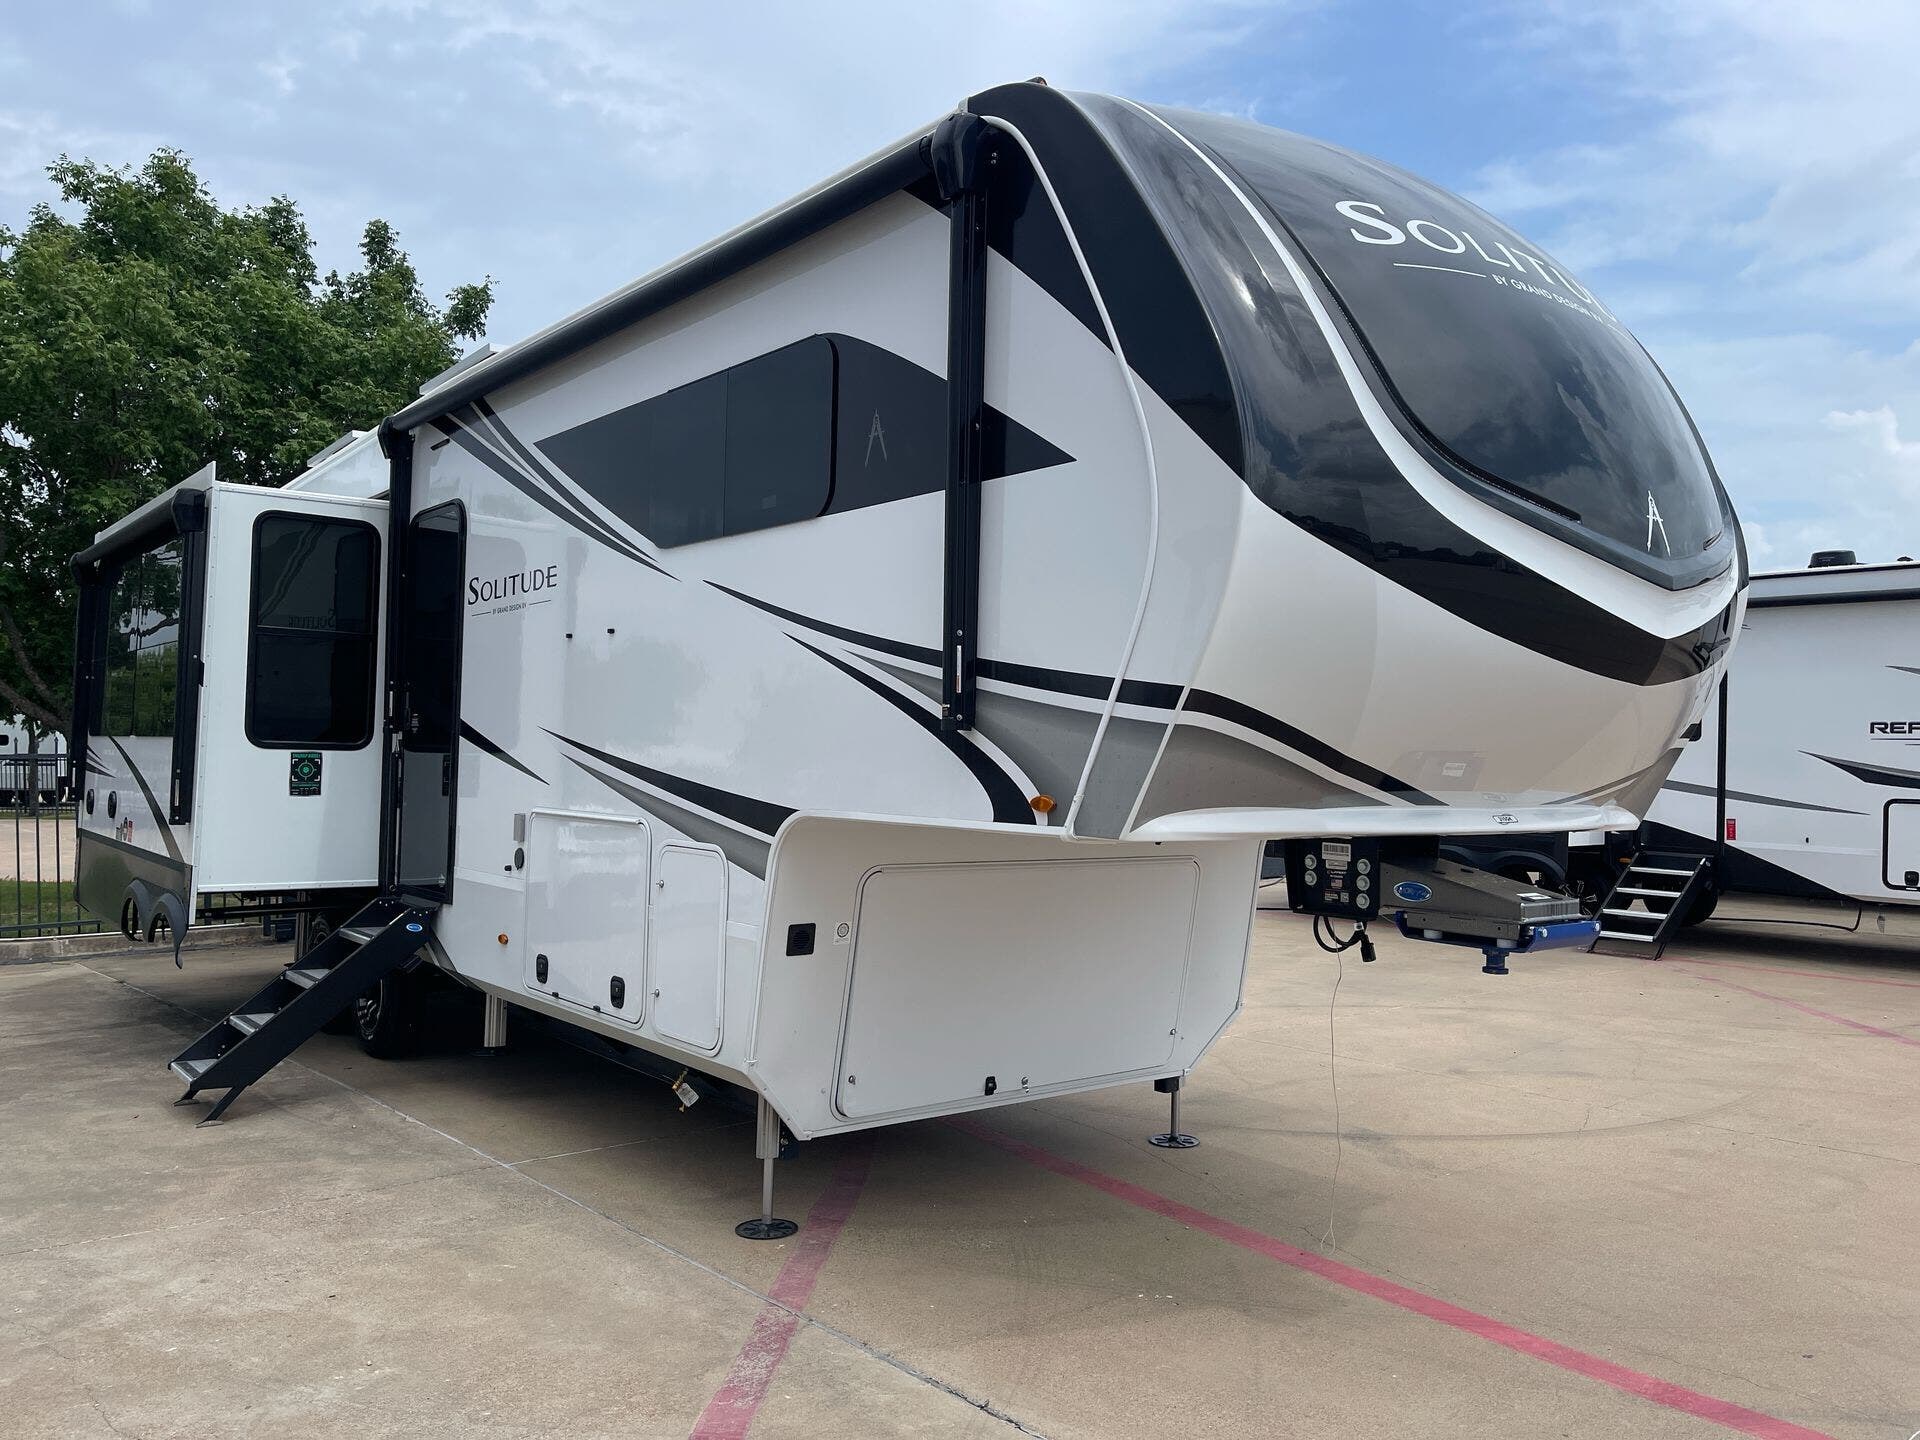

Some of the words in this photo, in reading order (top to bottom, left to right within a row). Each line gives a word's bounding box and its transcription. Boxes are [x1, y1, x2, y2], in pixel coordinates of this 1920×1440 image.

[1492, 273, 1508, 287] BY
[1510, 279, 1553, 300] GRAND
[467, 565, 558, 606] SOLITUDE
